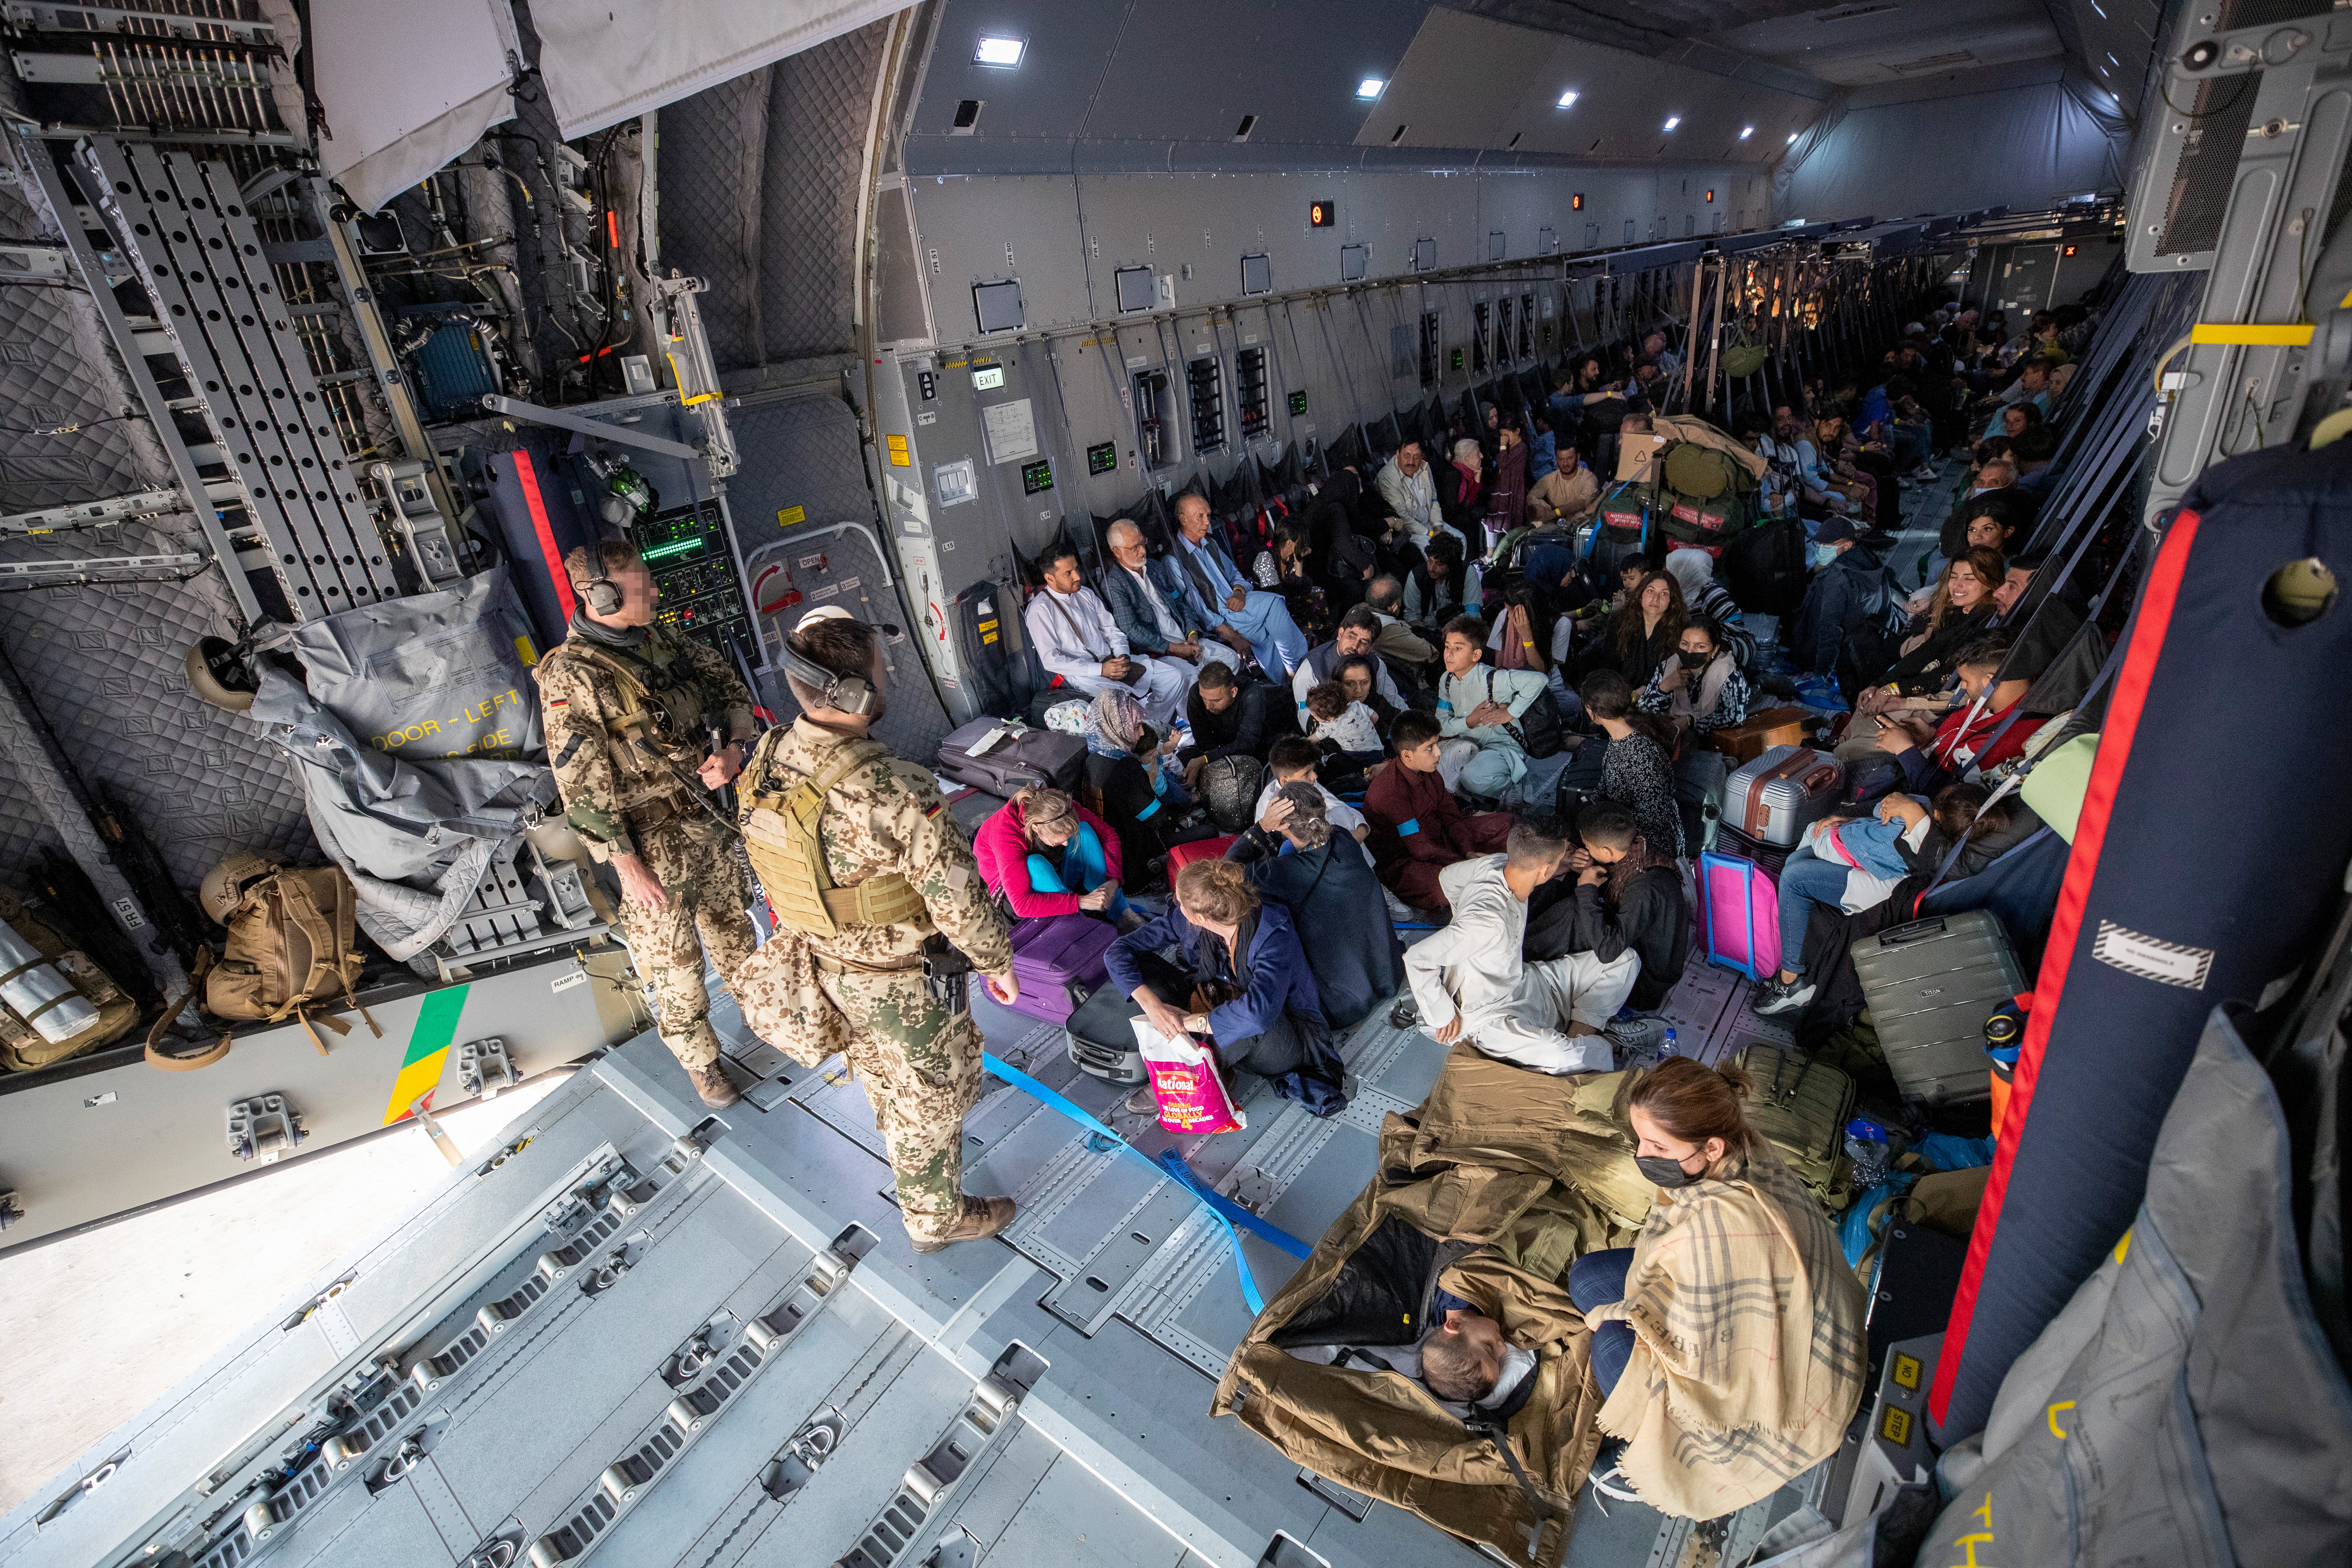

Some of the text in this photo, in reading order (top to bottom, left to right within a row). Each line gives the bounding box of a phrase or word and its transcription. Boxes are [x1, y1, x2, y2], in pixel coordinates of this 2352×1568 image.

[1092, 236, 1098, 257] FR 49
[1148, 233, 1154, 253] FR 48
[1207, 239, 1211, 248] FR
[931, 250, 940, 273] FR 51
[1006, 243, 1014, 266] FR 50
[979, 374, 996, 386] EXIT
[802, 557, 820, 566] OPEN
[371, 720, 441, 751] DOOR
[465, 689, 518, 723] LEFT
[115, 899, 142, 928] FR 57
[554, 976, 574, 988] RAMP
[4, 1027, 19, 1038] TQ
[1157, 1077, 1194, 1090] National
[1164, 1111, 1203, 1119] GLOBALLY
[1181, 1119, 1193, 1130] 4
[1188, 1115, 1214, 1123] DECADES
[1902, 1364, 1913, 1378] NO
[1891, 1414, 1903, 1438] STEP
